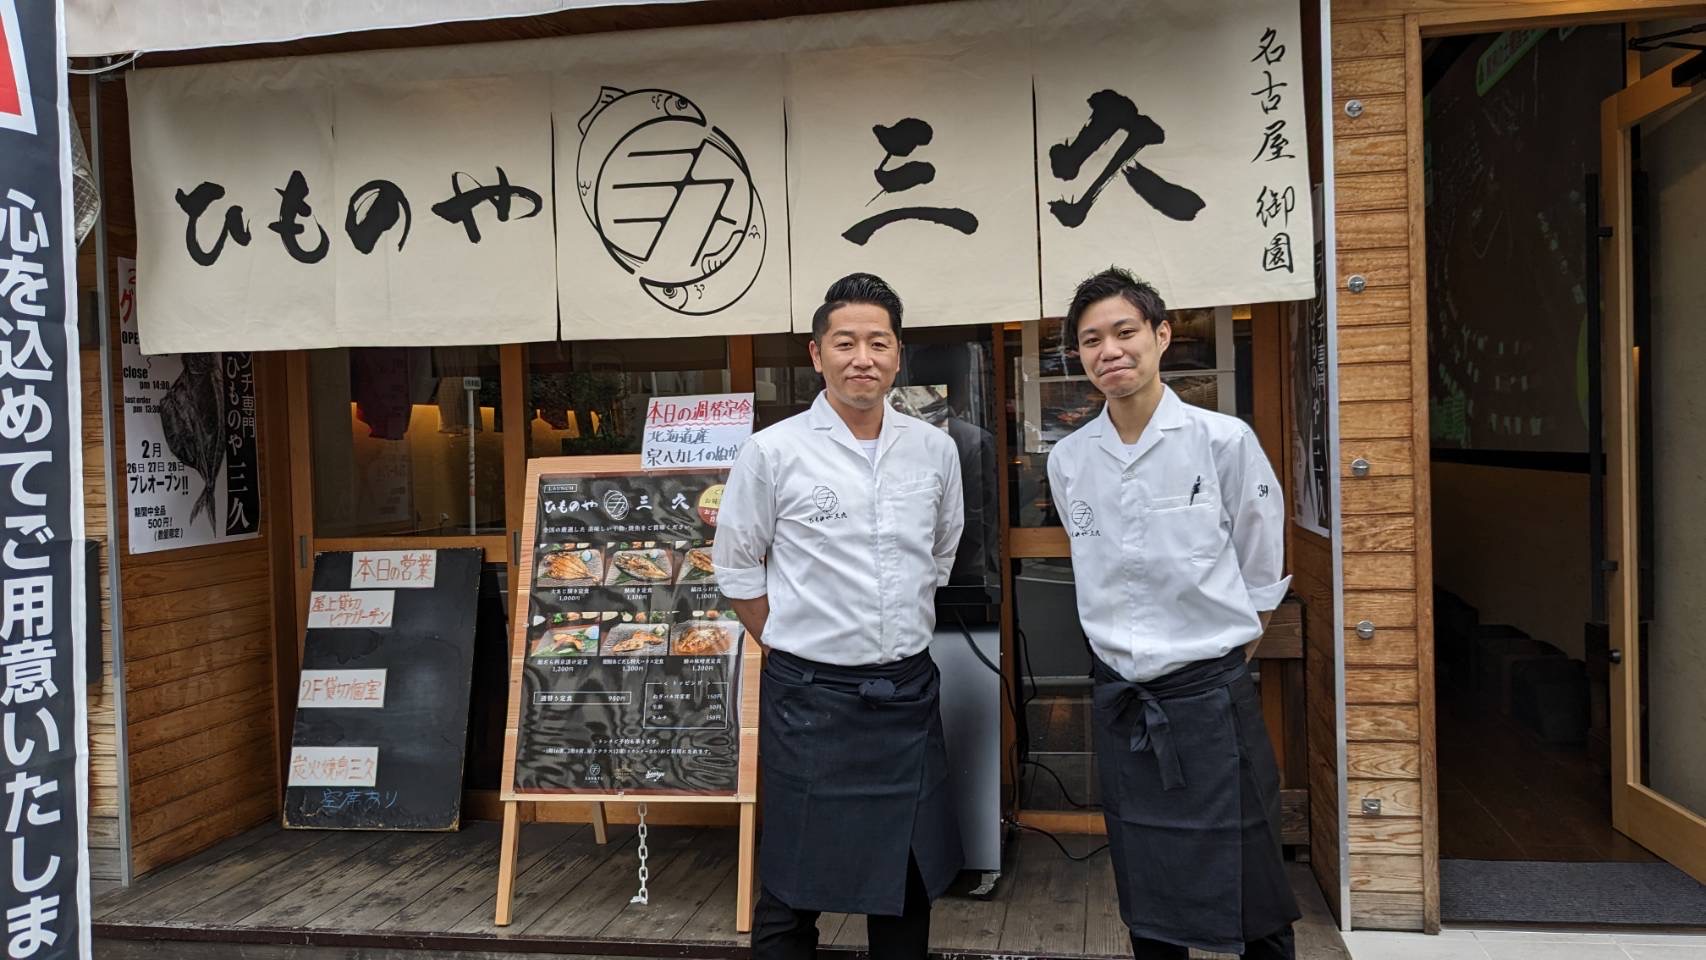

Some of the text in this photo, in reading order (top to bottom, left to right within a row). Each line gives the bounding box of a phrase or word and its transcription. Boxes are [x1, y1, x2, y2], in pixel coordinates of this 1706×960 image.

[1251, 27, 1295, 274] 名古屋 御園
[174, 166, 544, 267] ひものや
[122, 331, 139, 345] OPE
[123, 366, 149, 379] close
[226, 356, 250, 530] ひものや三久
[648, 426, 711, 444] 北海道産
[141, 439, 162, 459] 2月
[127, 461, 185, 473] 26日 27日 28日
[544, 500, 599, 513] ひものや
[354, 553, 433, 582] 本日の営業
[312, 592, 362, 612] 屋上貸切
[302, 675, 381, 701] 2F貸切個室
